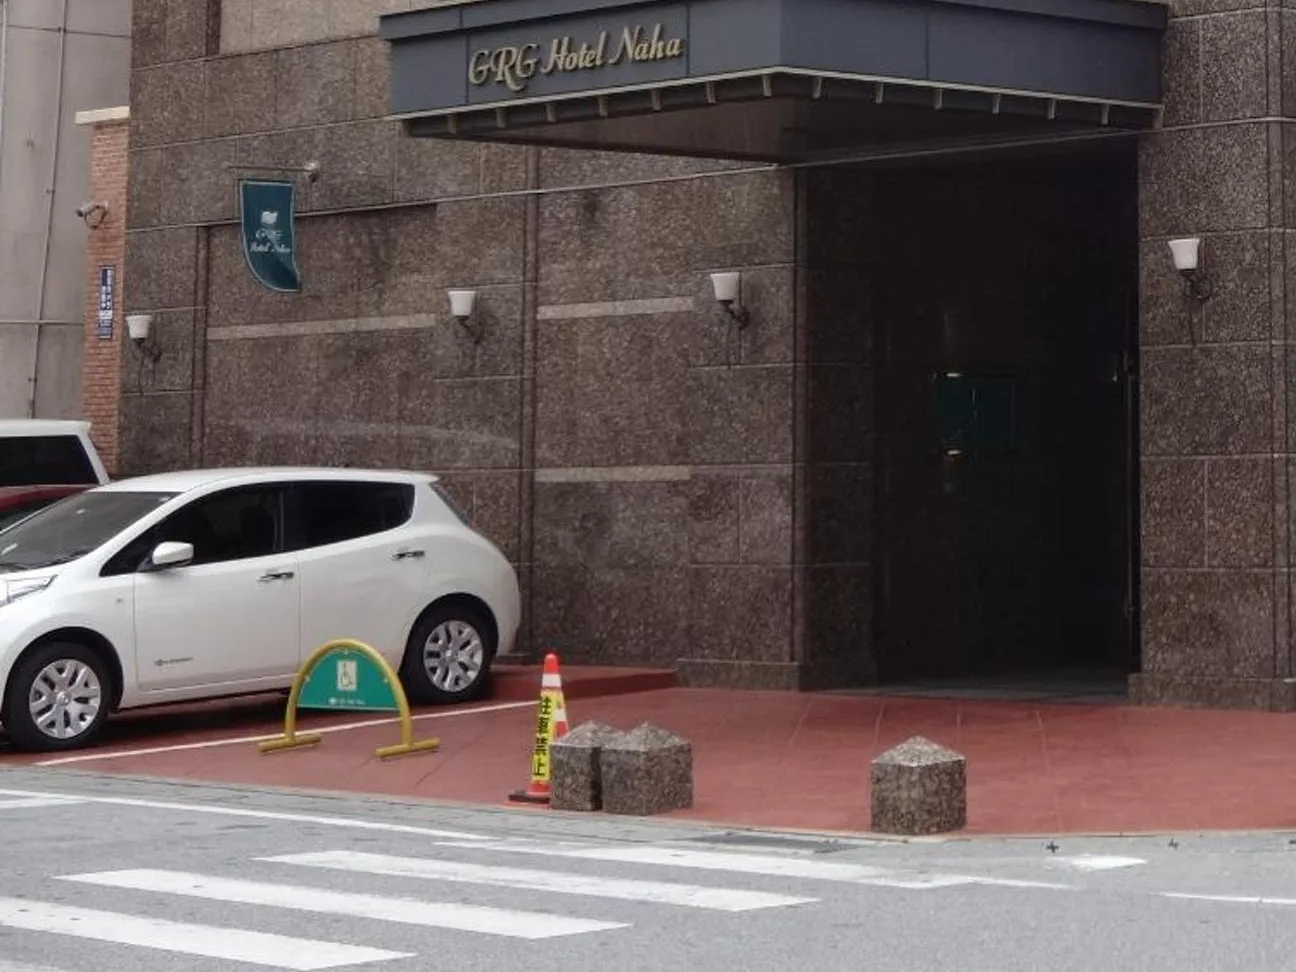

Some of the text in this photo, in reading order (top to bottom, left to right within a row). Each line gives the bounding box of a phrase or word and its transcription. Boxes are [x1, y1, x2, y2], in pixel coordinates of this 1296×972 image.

[468, 23, 684, 91] GRG Hotel Naha
